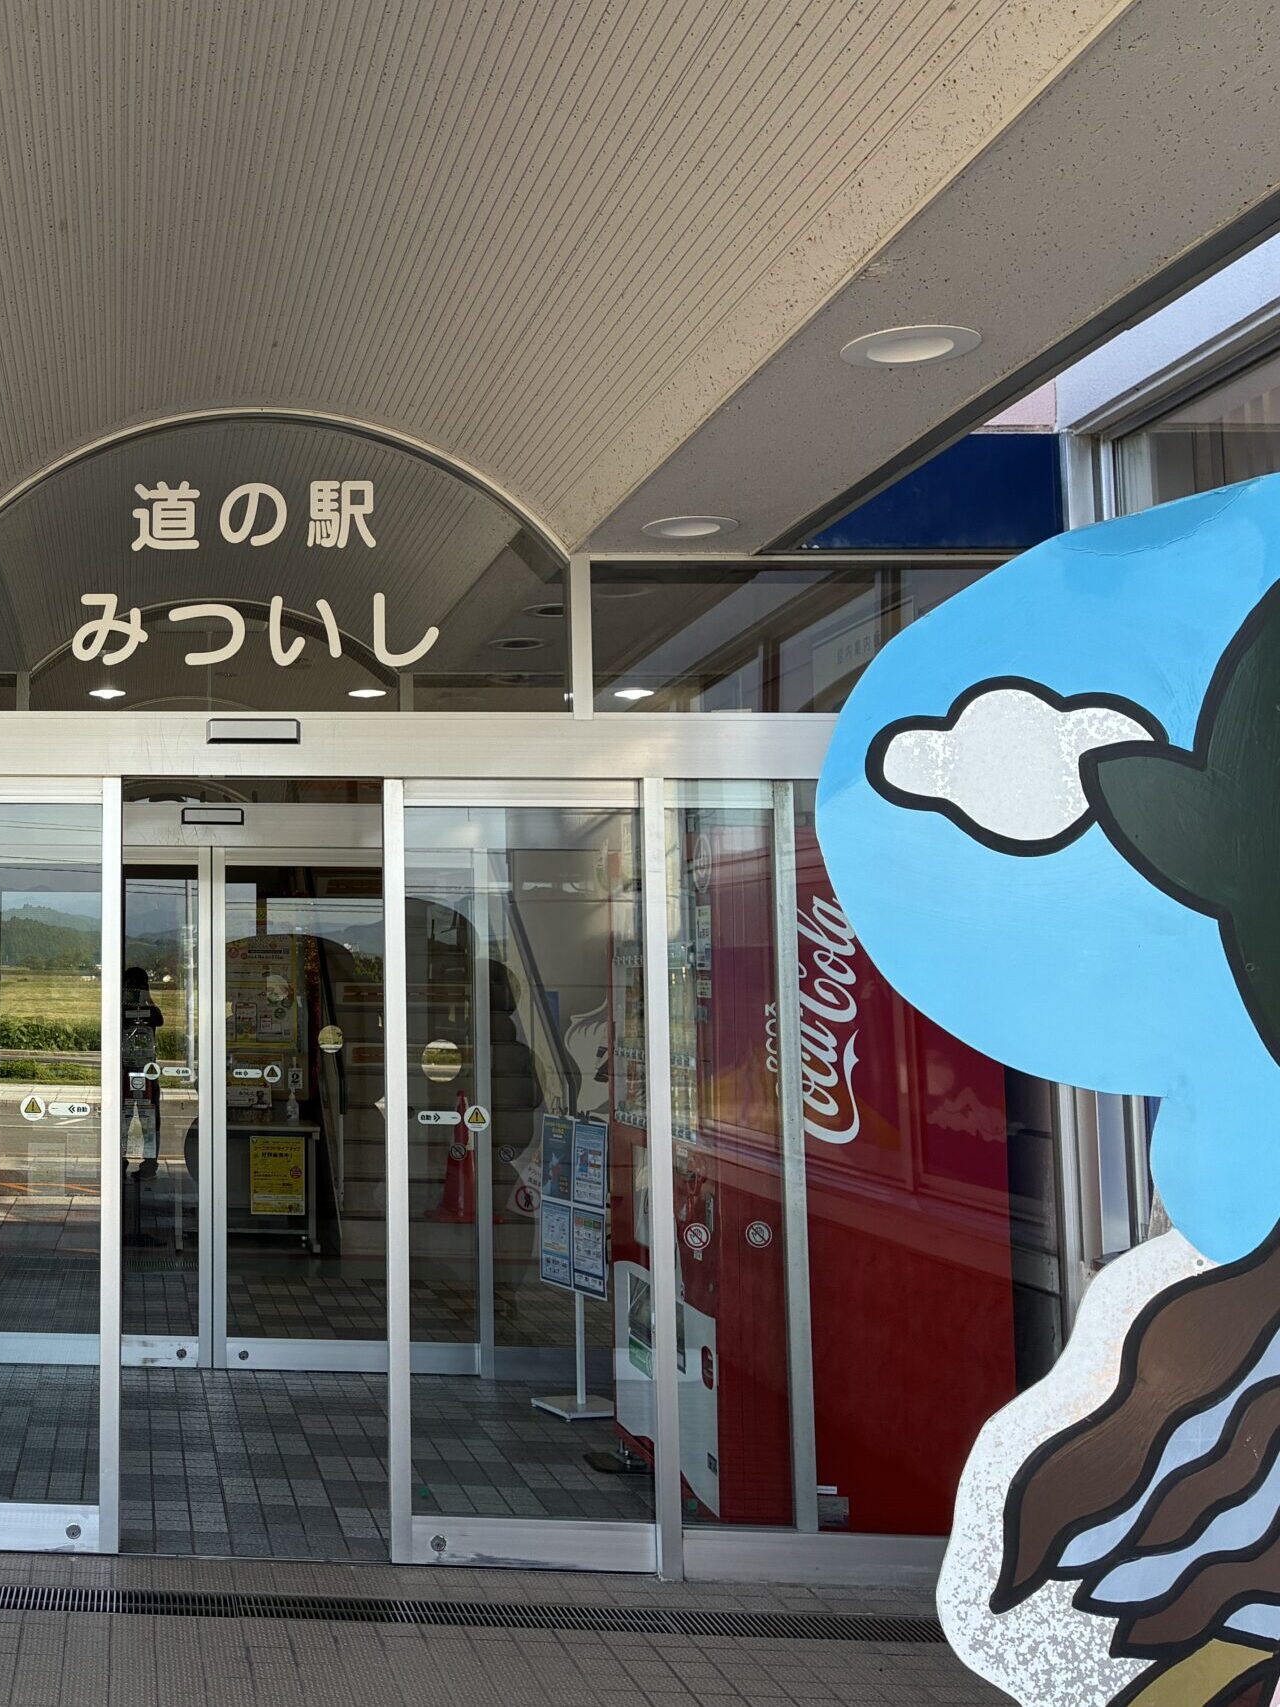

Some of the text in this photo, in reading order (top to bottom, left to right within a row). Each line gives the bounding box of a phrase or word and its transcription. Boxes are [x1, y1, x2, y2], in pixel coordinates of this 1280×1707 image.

[131, 480, 377, 551] 道の駅
[71, 592, 440, 667] みついし
